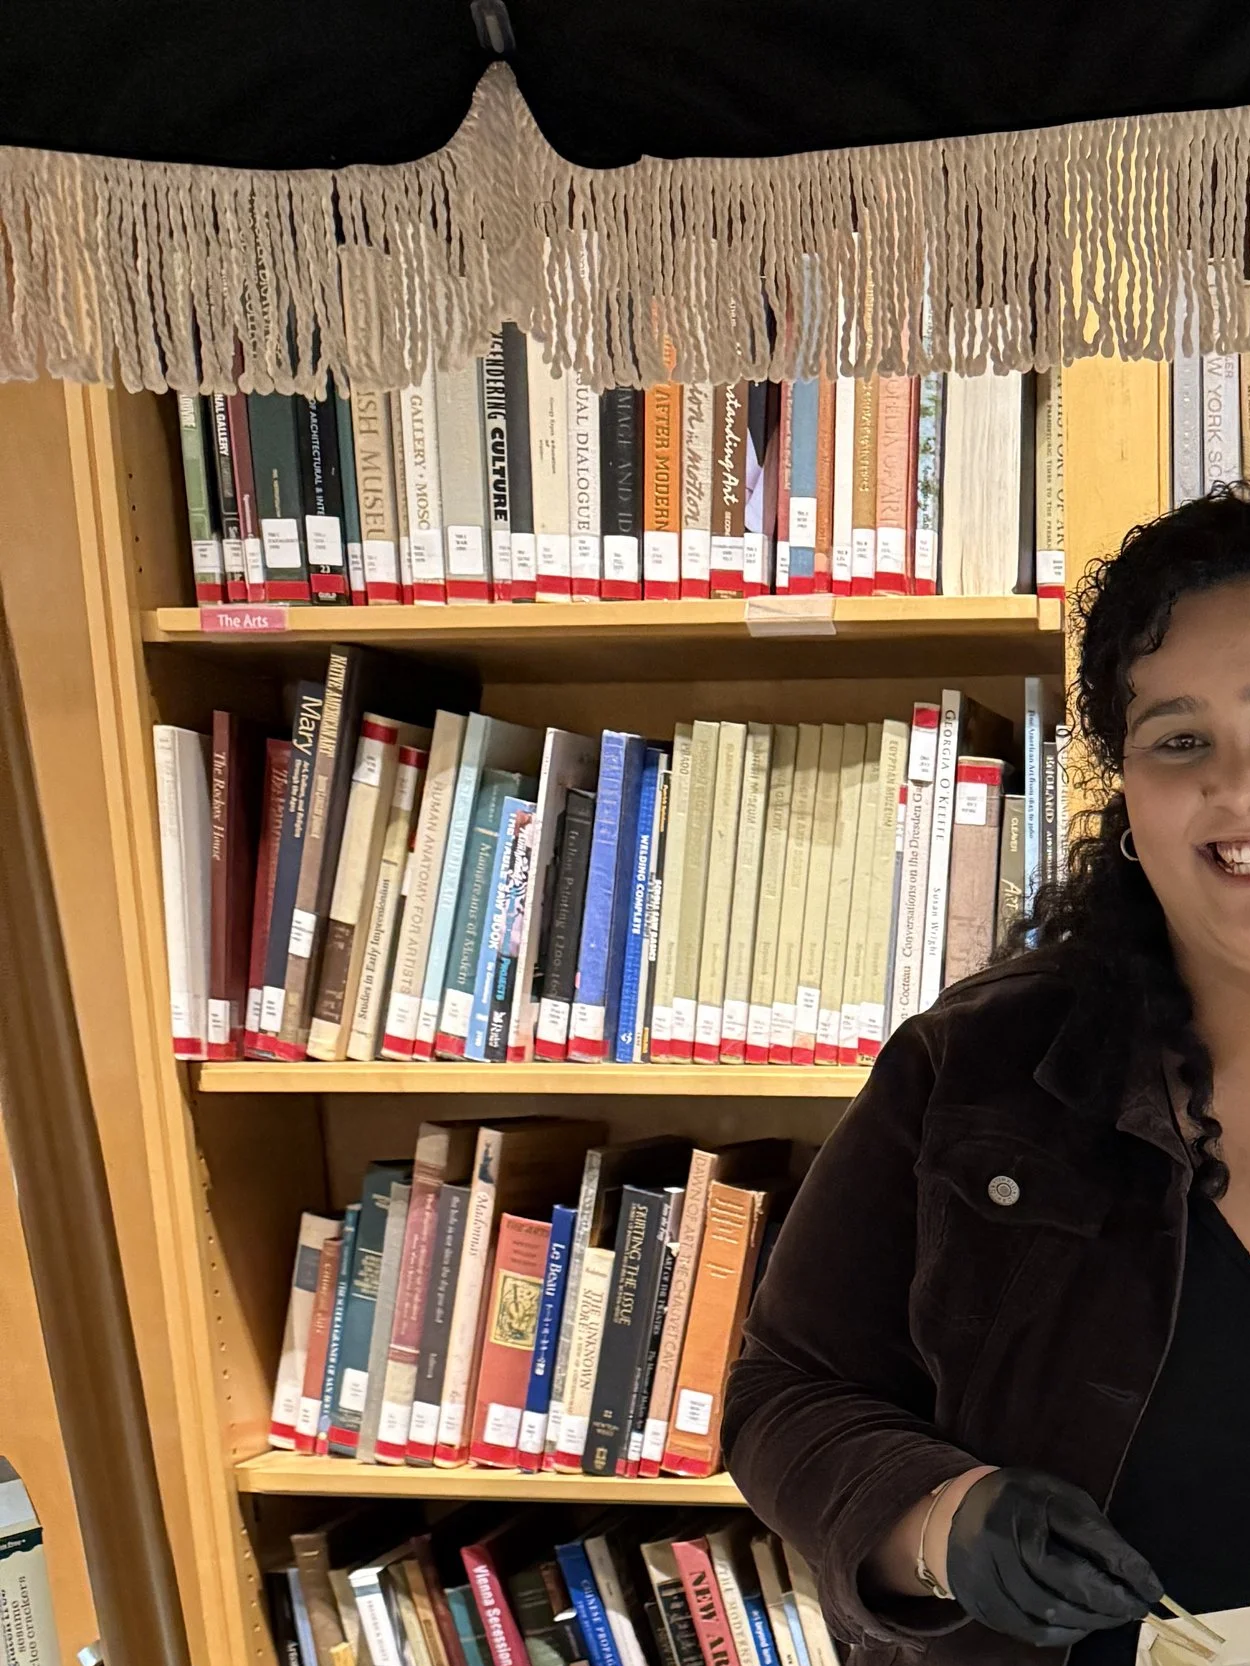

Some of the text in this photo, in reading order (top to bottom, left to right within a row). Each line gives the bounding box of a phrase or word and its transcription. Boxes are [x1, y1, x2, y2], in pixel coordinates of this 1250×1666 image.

[408, 395, 427, 470] GALLERY
[1208, 384, 1224, 443] YORK
[310, 412, 324, 485] ARCHITECTURAL
[490, 427, 509, 522] CULTURE
[576, 433, 592, 532] DIALOGUE
[217, 613, 269, 630] The Arts
[292, 695, 324, 756] Mary
[939, 708, 957, 770] GEORGIA
[427, 780, 444, 827] HUMAN
[507, 813, 518, 839] THE
[418, 833, 439, 904] ANATOMY
[467, 842, 492, 921] Mainstreams
[498, 840, 514, 877] TABLE
[630, 834, 651, 935] WELDING COMPLETE
[903, 804, 922, 958] Conversations on the Dresden
[412, 905, 426, 933] FOR
[465, 922, 475, 932] of
[931, 887, 942, 918] Susan
[357, 879, 391, 1021] Studies in Early Impressionism
[455, 932, 474, 985] Modern
[487, 915, 502, 951] BOOK
[899, 964, 912, 1007] Cocteau
[630, 1204, 650, 1256] SKIRTING
[545, 1241, 567, 1297] Le Beau
[626, 1257, 641, 1284] THE
[660, 1154, 708, 1373] DAWN OF ART THE CHAUVET CAVE
[664, 1253, 674, 1270] ART
[620, 1284, 638, 1328] ISSUE
[659, 1282, 669, 1296] THE
[579, 1290, 606, 1394] THE UNKNOWN
[19, 1576, 37, 1641] crackers
[472, 1563, 496, 1608] Vienna
[580, 1579, 604, 1622] CHINESE
[688, 1569, 720, 1625] NEW
[715, 1560, 735, 1593] THE
[727, 1602, 754, 1664] MODERNS
[11, 1600, 25, 1653] sesame
[753, 1621, 770, 1648] beyond
